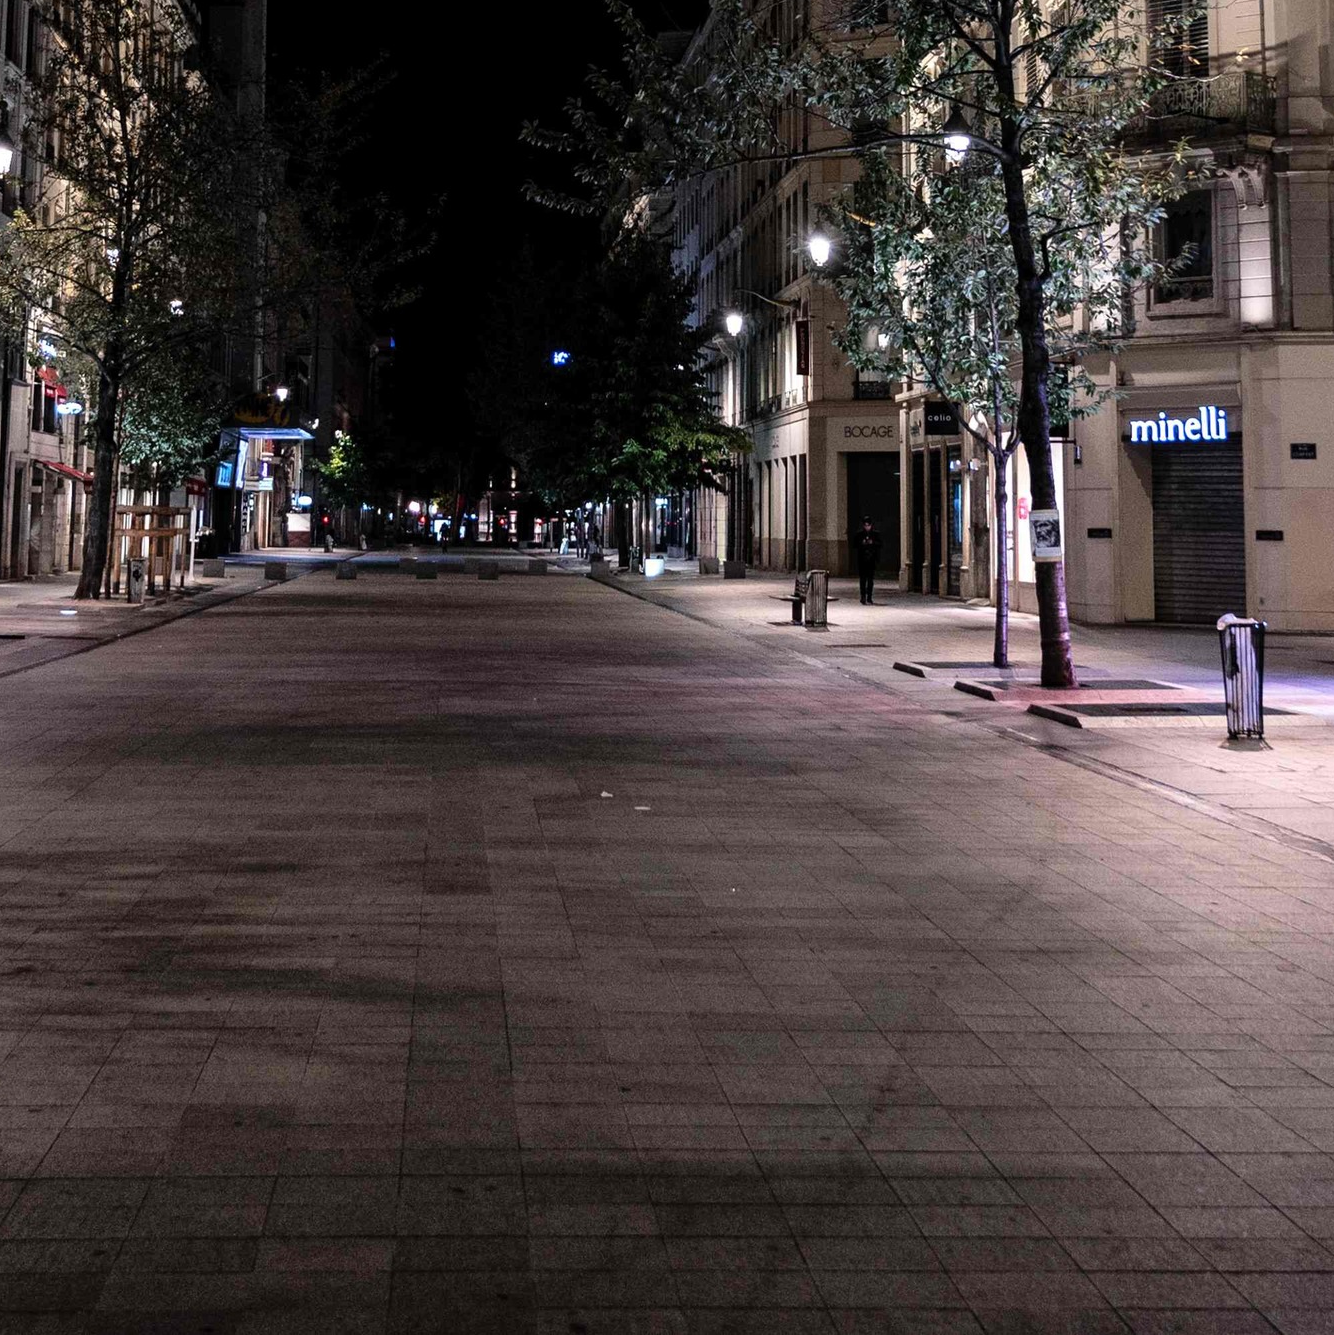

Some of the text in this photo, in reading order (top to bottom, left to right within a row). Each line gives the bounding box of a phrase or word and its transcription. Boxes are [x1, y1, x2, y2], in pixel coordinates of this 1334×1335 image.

[927, 413, 952, 422] celio
[1130, 406, 1227, 442] minelli
[844, 426, 894, 438] BOCAGE
